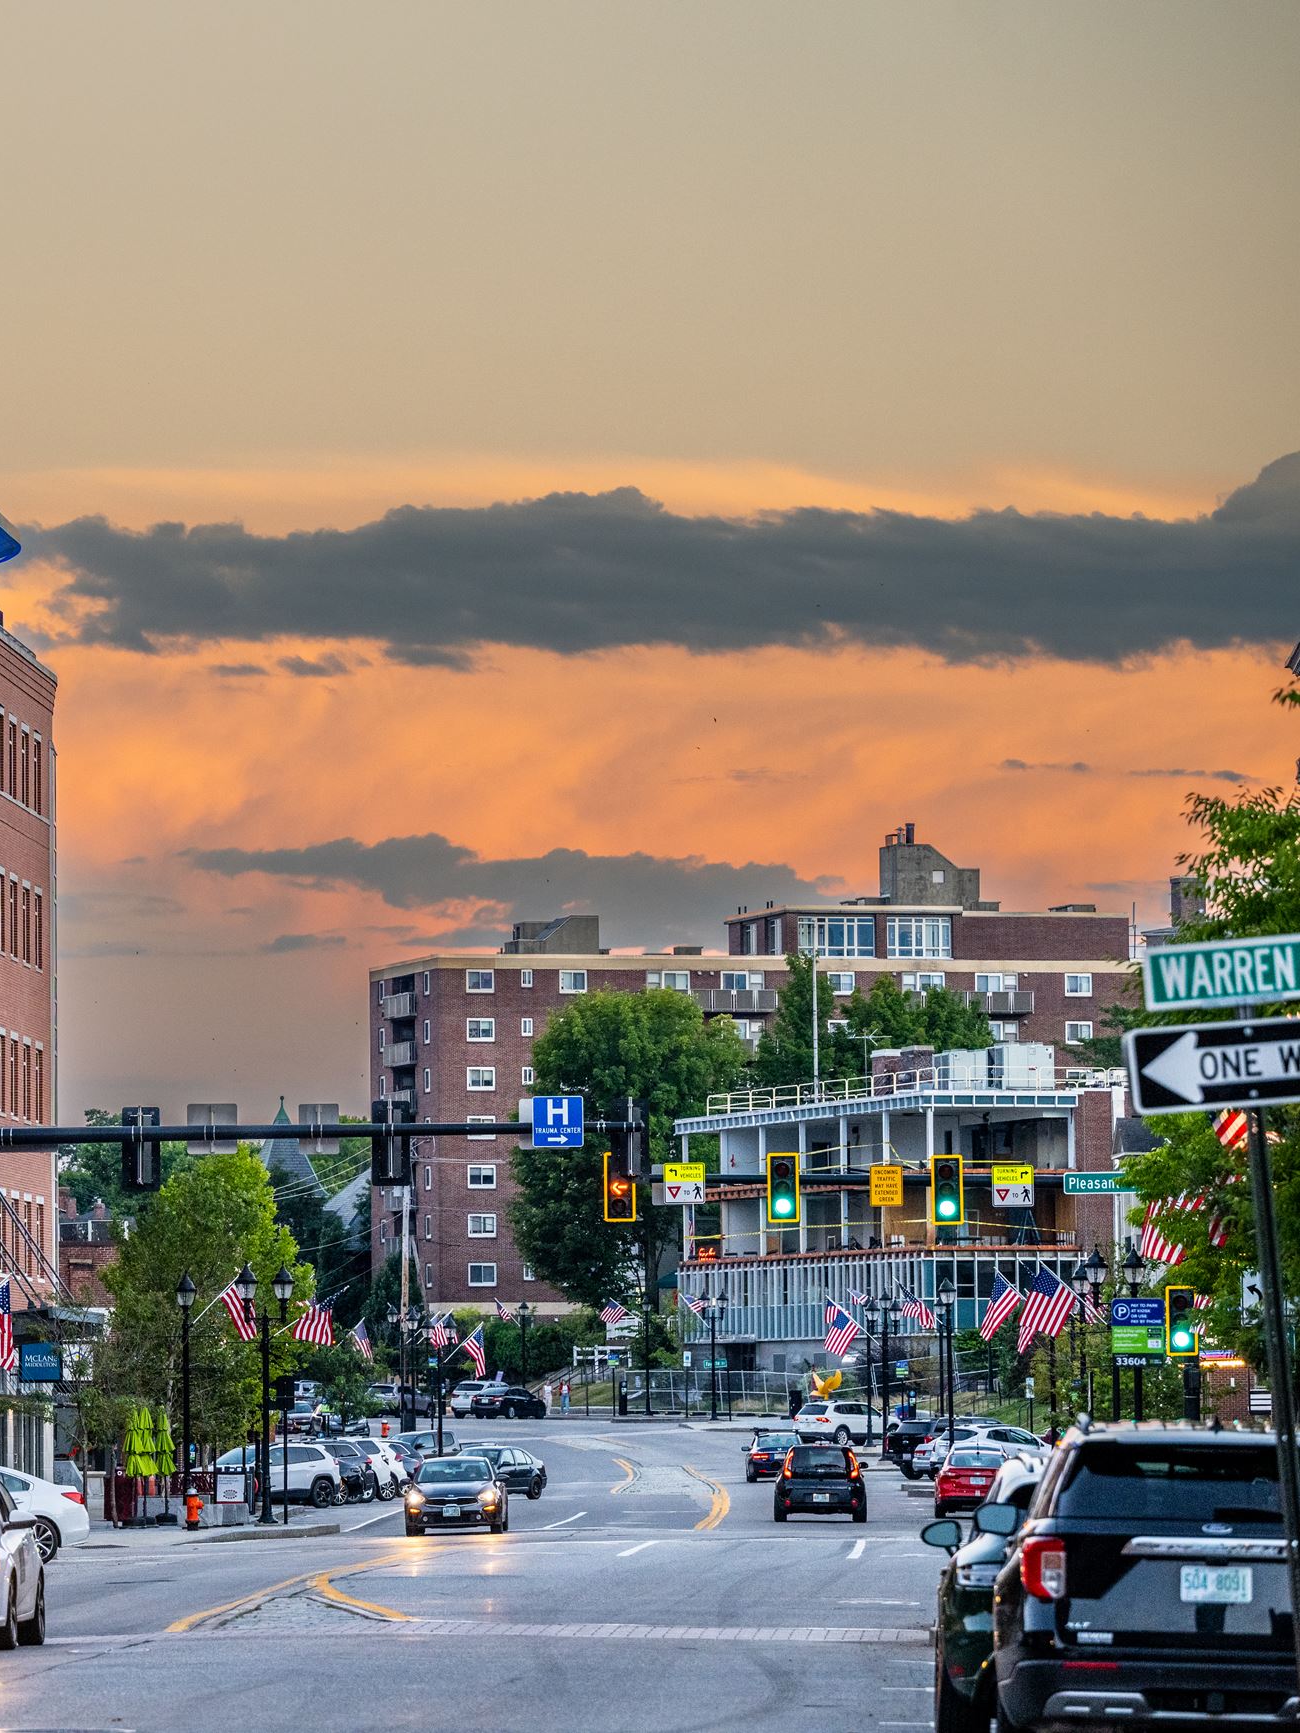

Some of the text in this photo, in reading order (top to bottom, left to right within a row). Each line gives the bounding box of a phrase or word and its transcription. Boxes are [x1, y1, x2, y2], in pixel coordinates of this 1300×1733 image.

[1158, 945, 1296, 1000] WARREN
[1200, 1048, 1262, 1080] ONE
[547, 1098, 569, 1126] H
[1116, 1357, 1147, 1366] 33604
